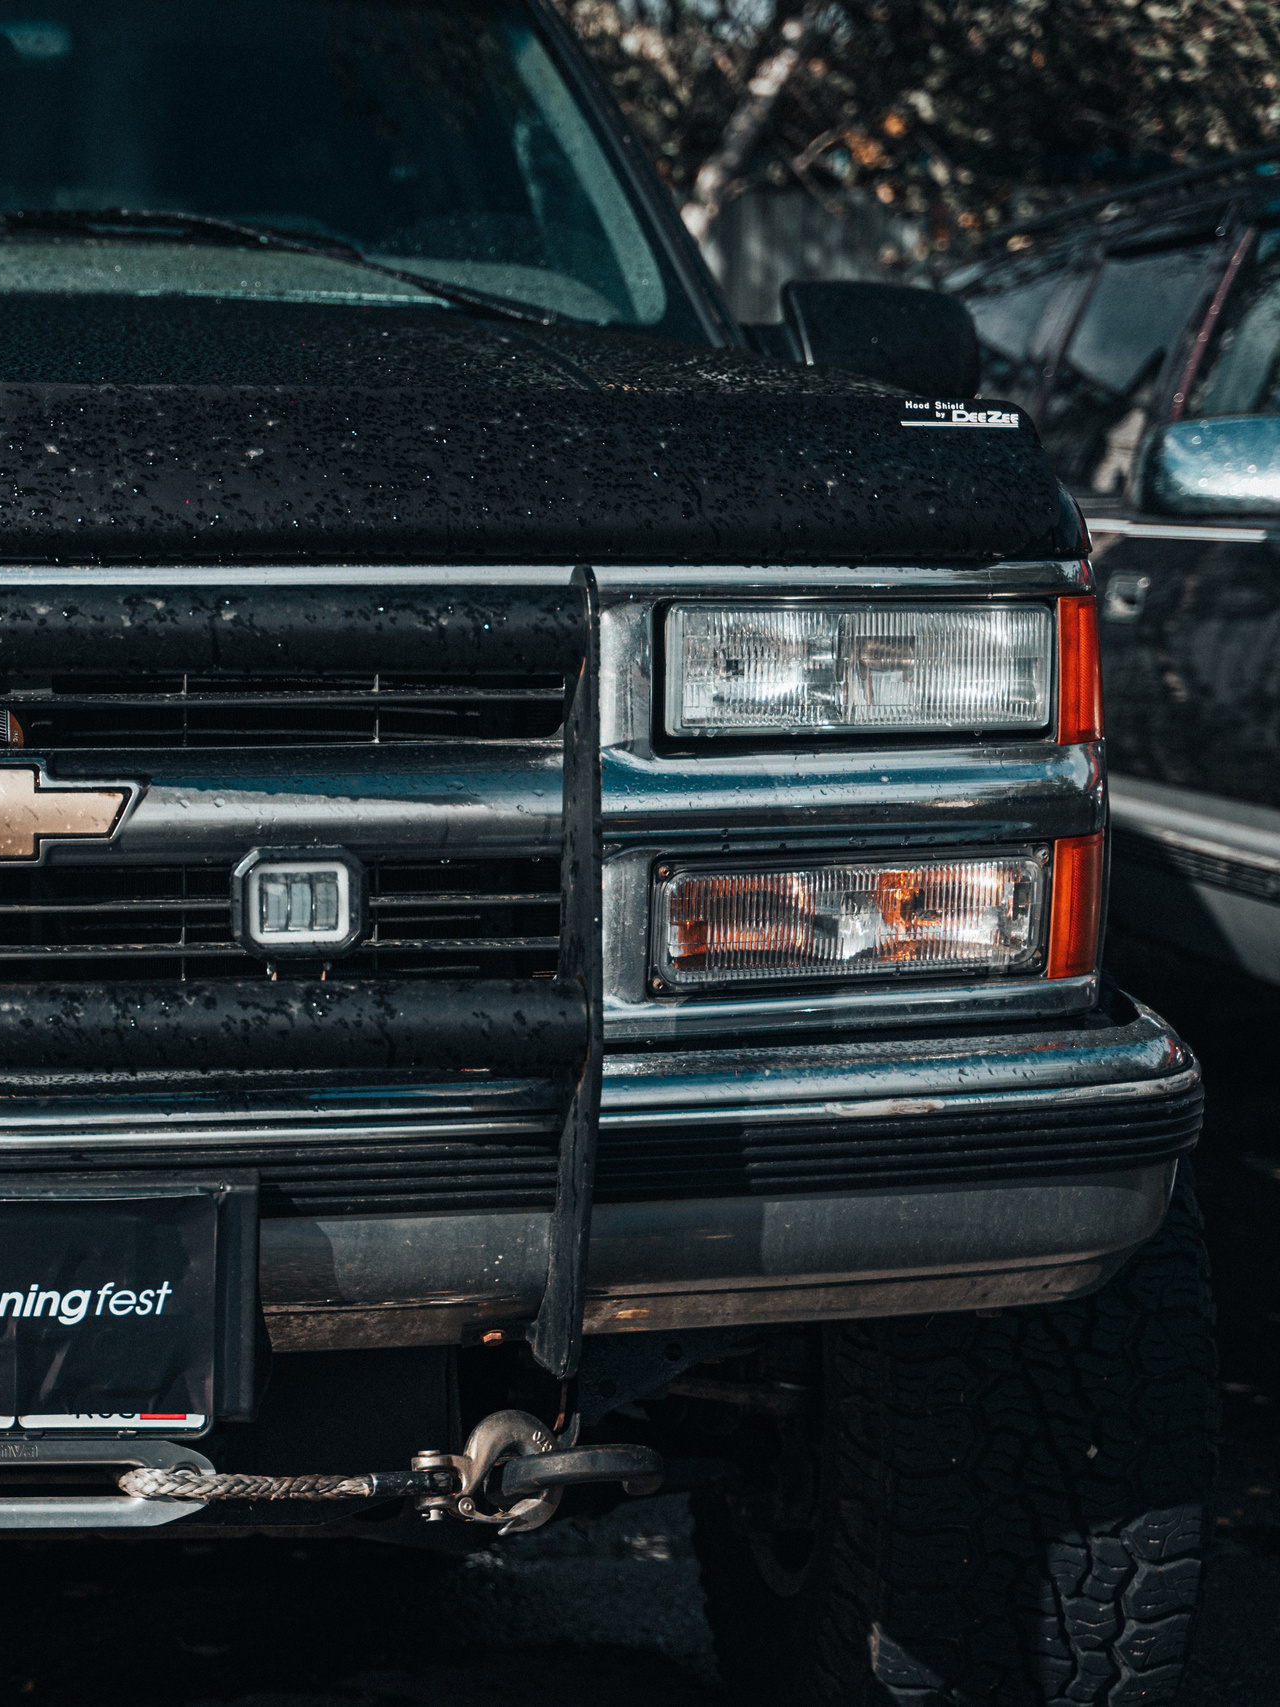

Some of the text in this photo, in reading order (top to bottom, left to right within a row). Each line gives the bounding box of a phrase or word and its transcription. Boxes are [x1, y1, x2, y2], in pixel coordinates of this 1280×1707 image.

[905, 400, 965, 410] Hood Shield
[935, 411, 946, 419] by
